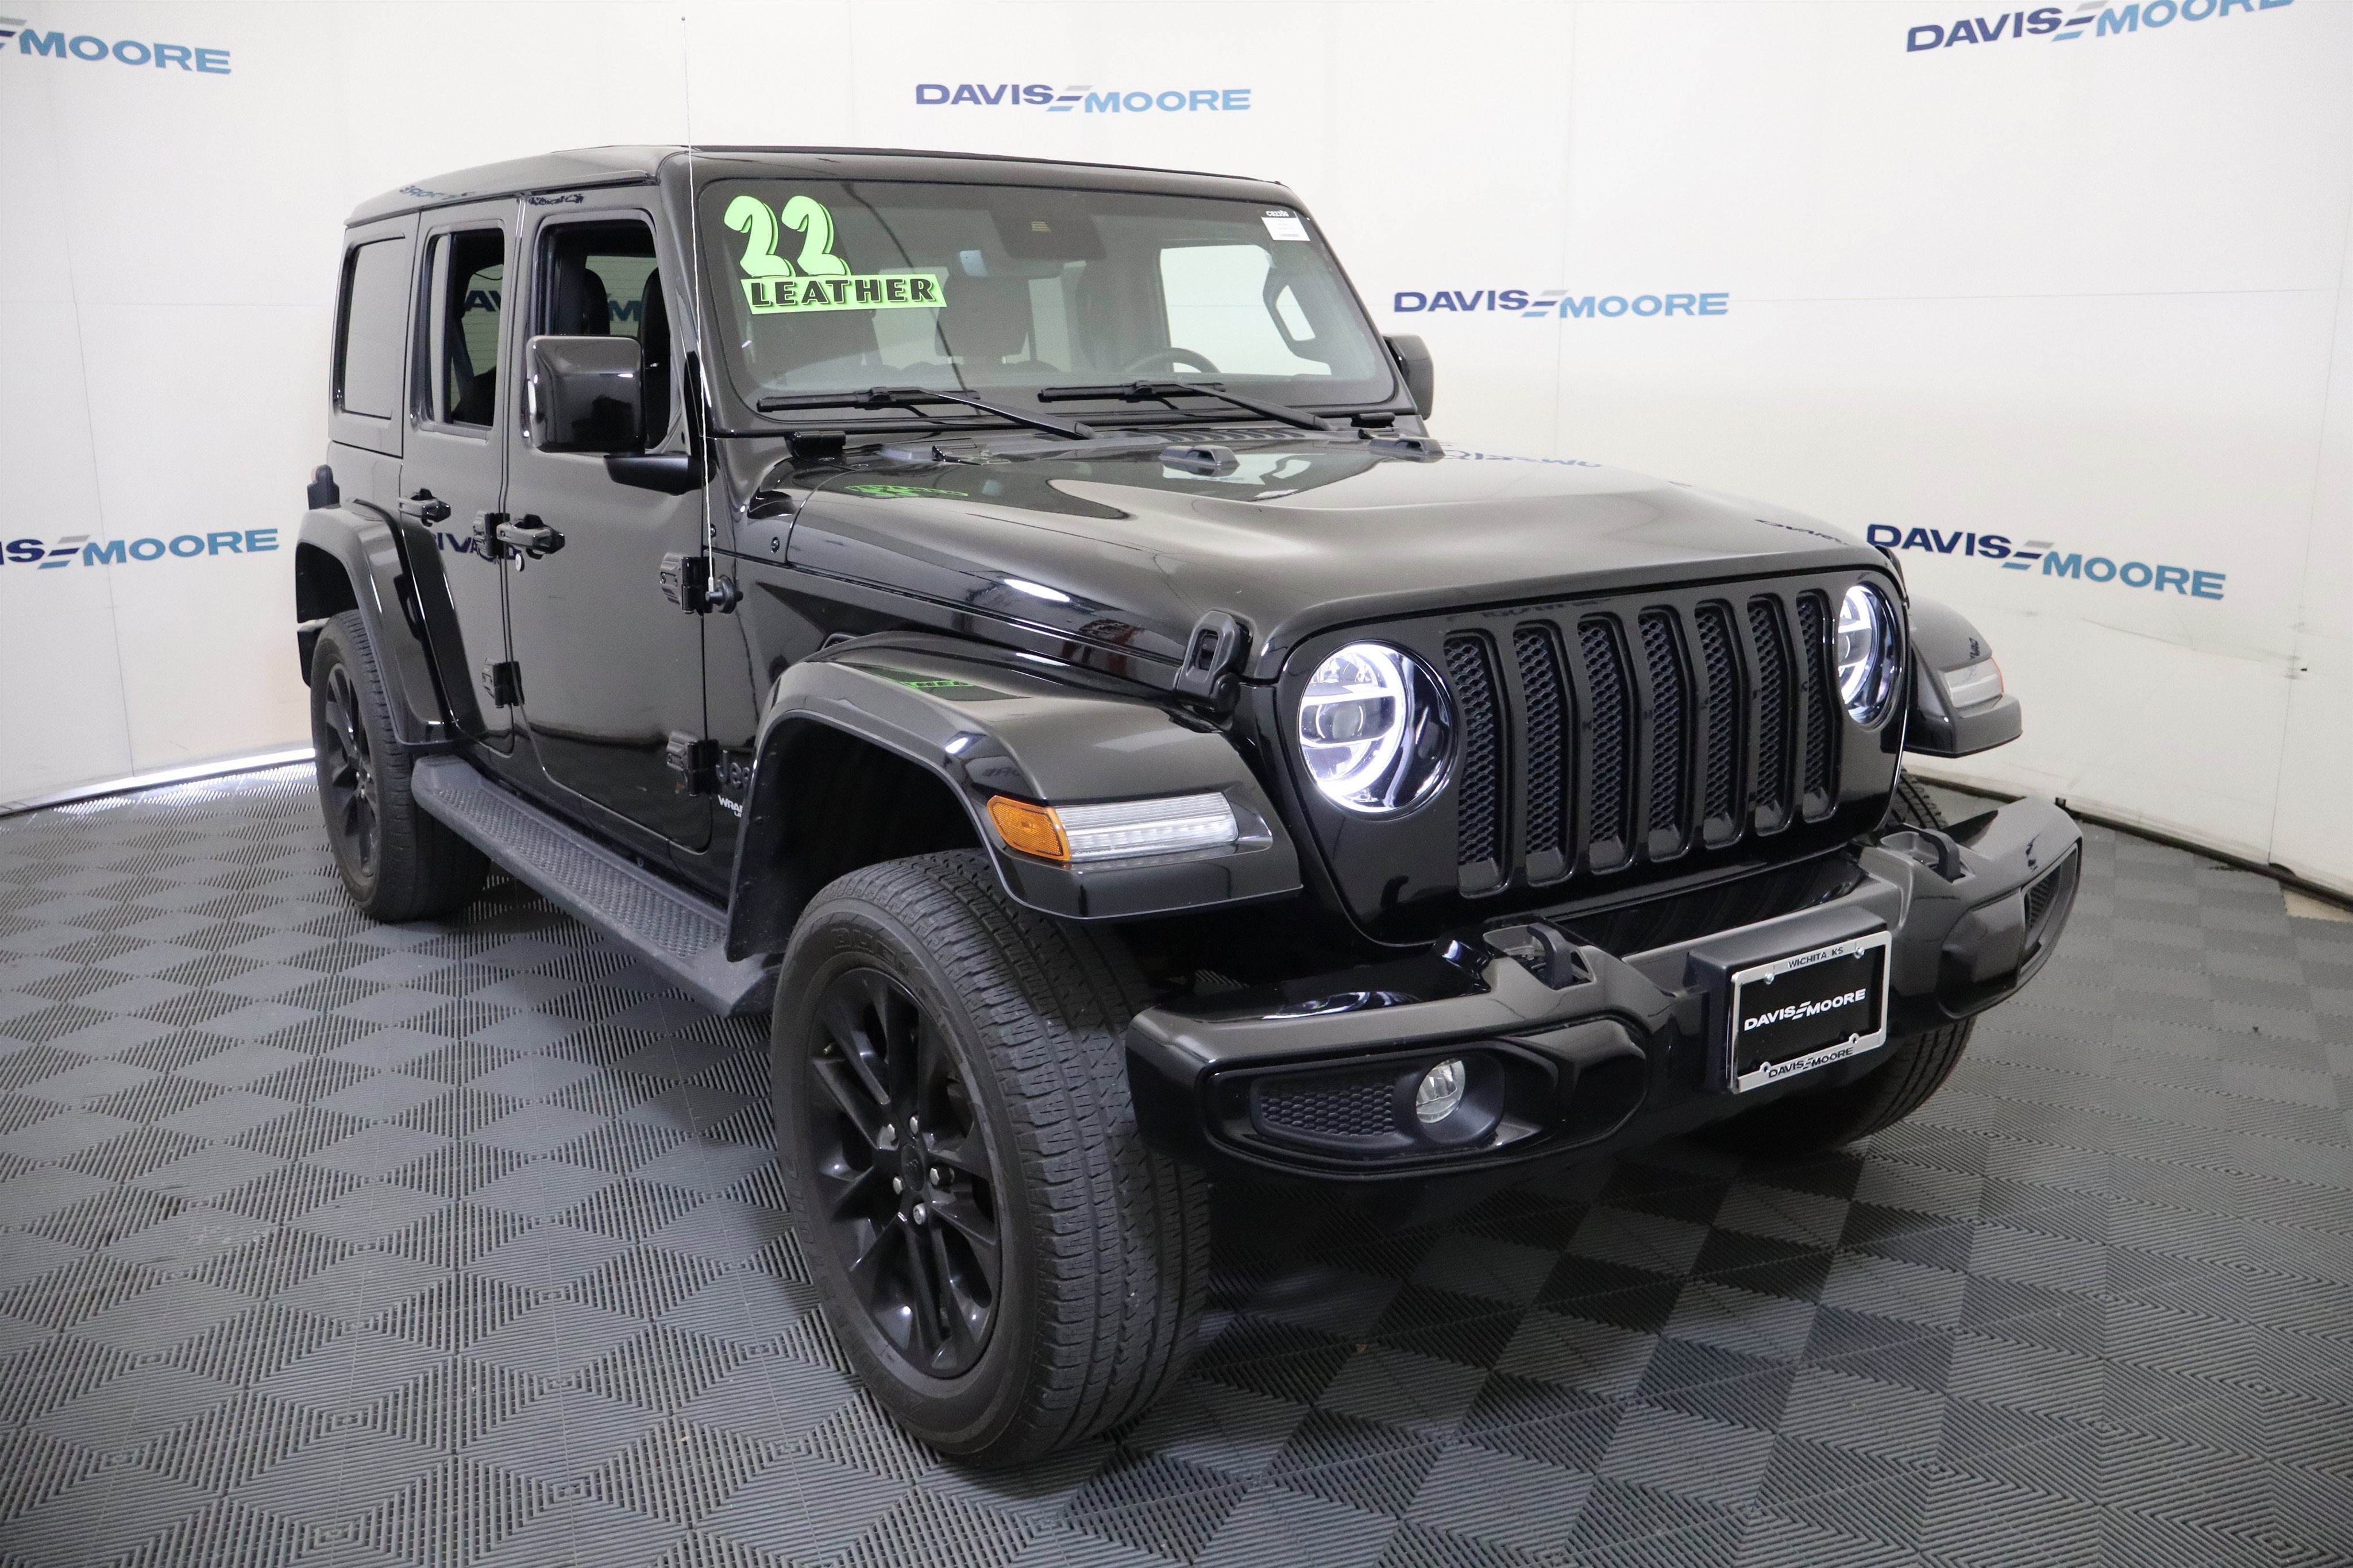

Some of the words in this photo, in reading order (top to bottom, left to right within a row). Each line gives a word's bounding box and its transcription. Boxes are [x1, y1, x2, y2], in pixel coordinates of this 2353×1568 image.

[1907, 8, 2062, 52] DAVIS
[19, 28, 231, 74] MOORE
[916, 84, 1054, 105] DAVIS
[1085, 90, 1250, 111] MOORE
[723, 195, 851, 277] 22
[750, 278, 935, 307] LEATHER
[1394, 289, 1529, 312] DAVIS
[1560, 293, 1729, 318] MOORE
[82, 528, 279, 567] MOORE
[1866, 523, 2011, 559] DAVIS
[2043, 551, 2227, 600] MOORE
[715, 750, 750, 790] Jee
[1831, 947, 1843, 956] KS
[1744, 1005, 1796, 1032] DAVIS
[1806, 988, 1866, 1017] MOORE
[1768, 1060, 1804, 1078] DAVIS
[1811, 1046, 1854, 1067] MOORE
